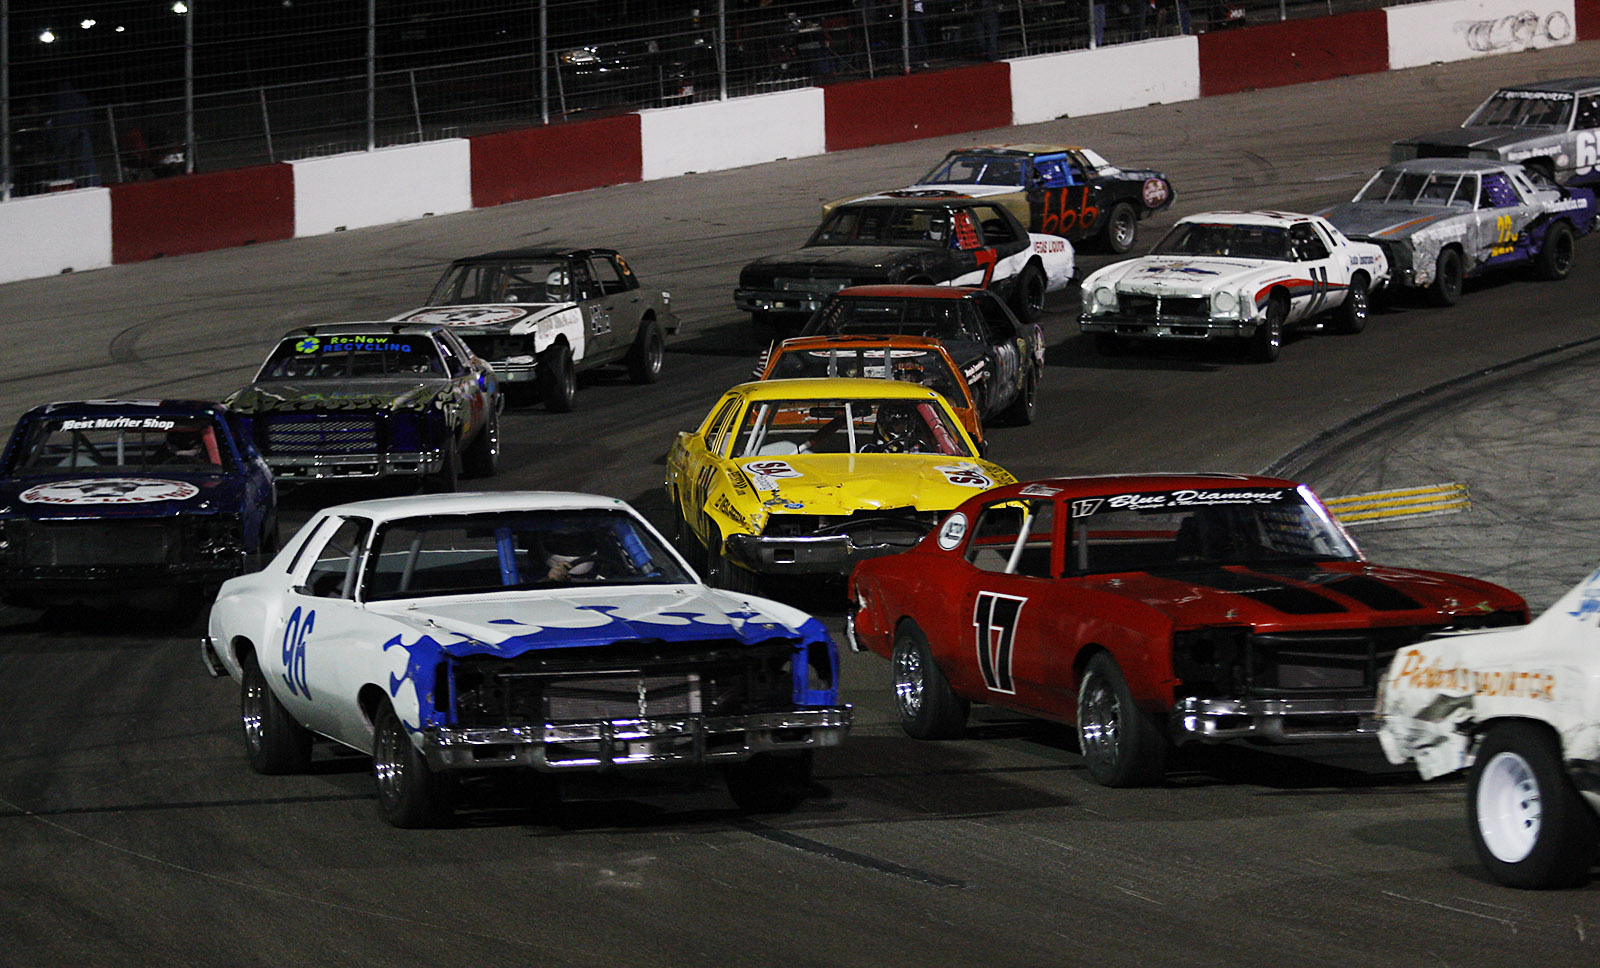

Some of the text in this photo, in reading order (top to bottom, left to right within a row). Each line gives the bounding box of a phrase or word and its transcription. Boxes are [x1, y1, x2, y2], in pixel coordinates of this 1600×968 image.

[323, 343, 411, 352] RECYCLING
[95, 418, 142, 429] Muffler
[143, 419, 174, 430] Shop
[1071, 490, 1284, 518] 17 Blue Diamond
[282, 605, 316, 702] 96
[973, 590, 1029, 695] 17
